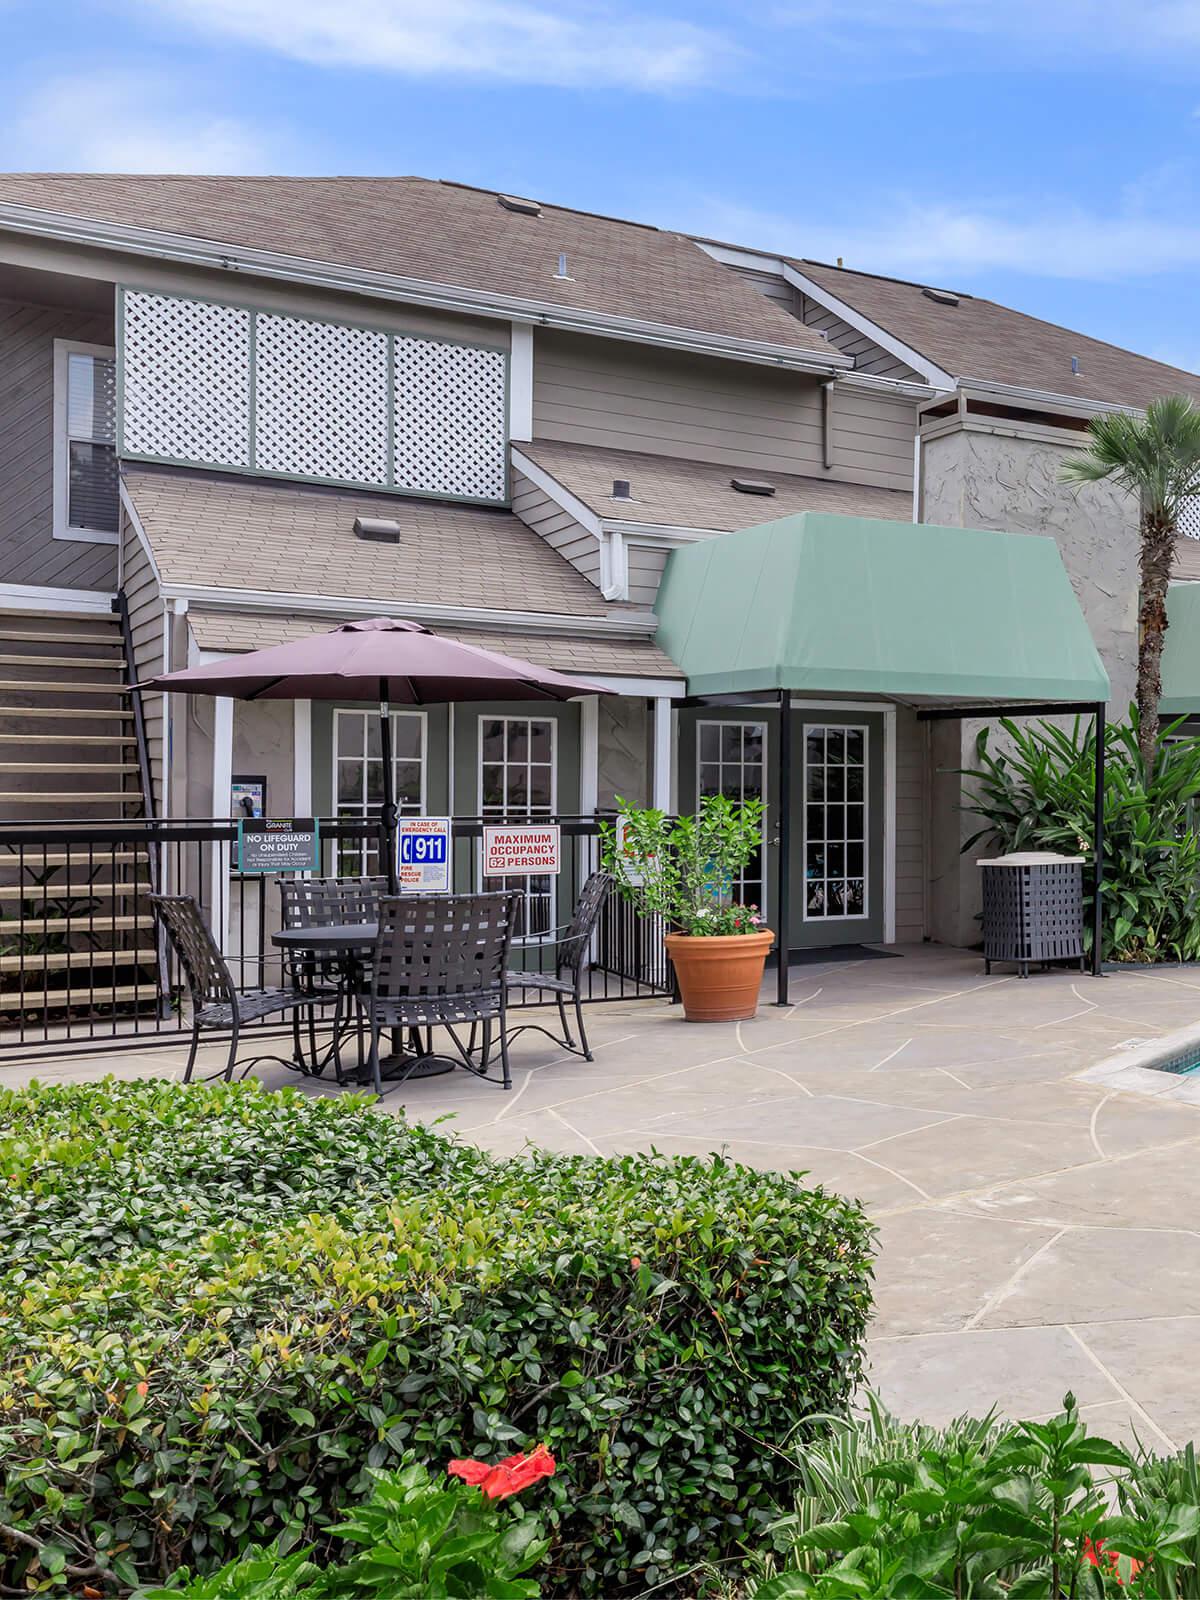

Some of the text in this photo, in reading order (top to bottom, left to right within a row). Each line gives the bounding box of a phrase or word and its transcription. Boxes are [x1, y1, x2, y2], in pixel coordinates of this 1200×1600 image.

[247, 834, 311, 843] NO LIFEGUARD
[494, 834, 551, 844] MAXIMUM
[277, 843, 298, 851] DUTY
[415, 838, 442, 859] 911
[490, 845, 554, 855] OCCUPANCY
[490, 857, 555, 867] 62 PERSONS
